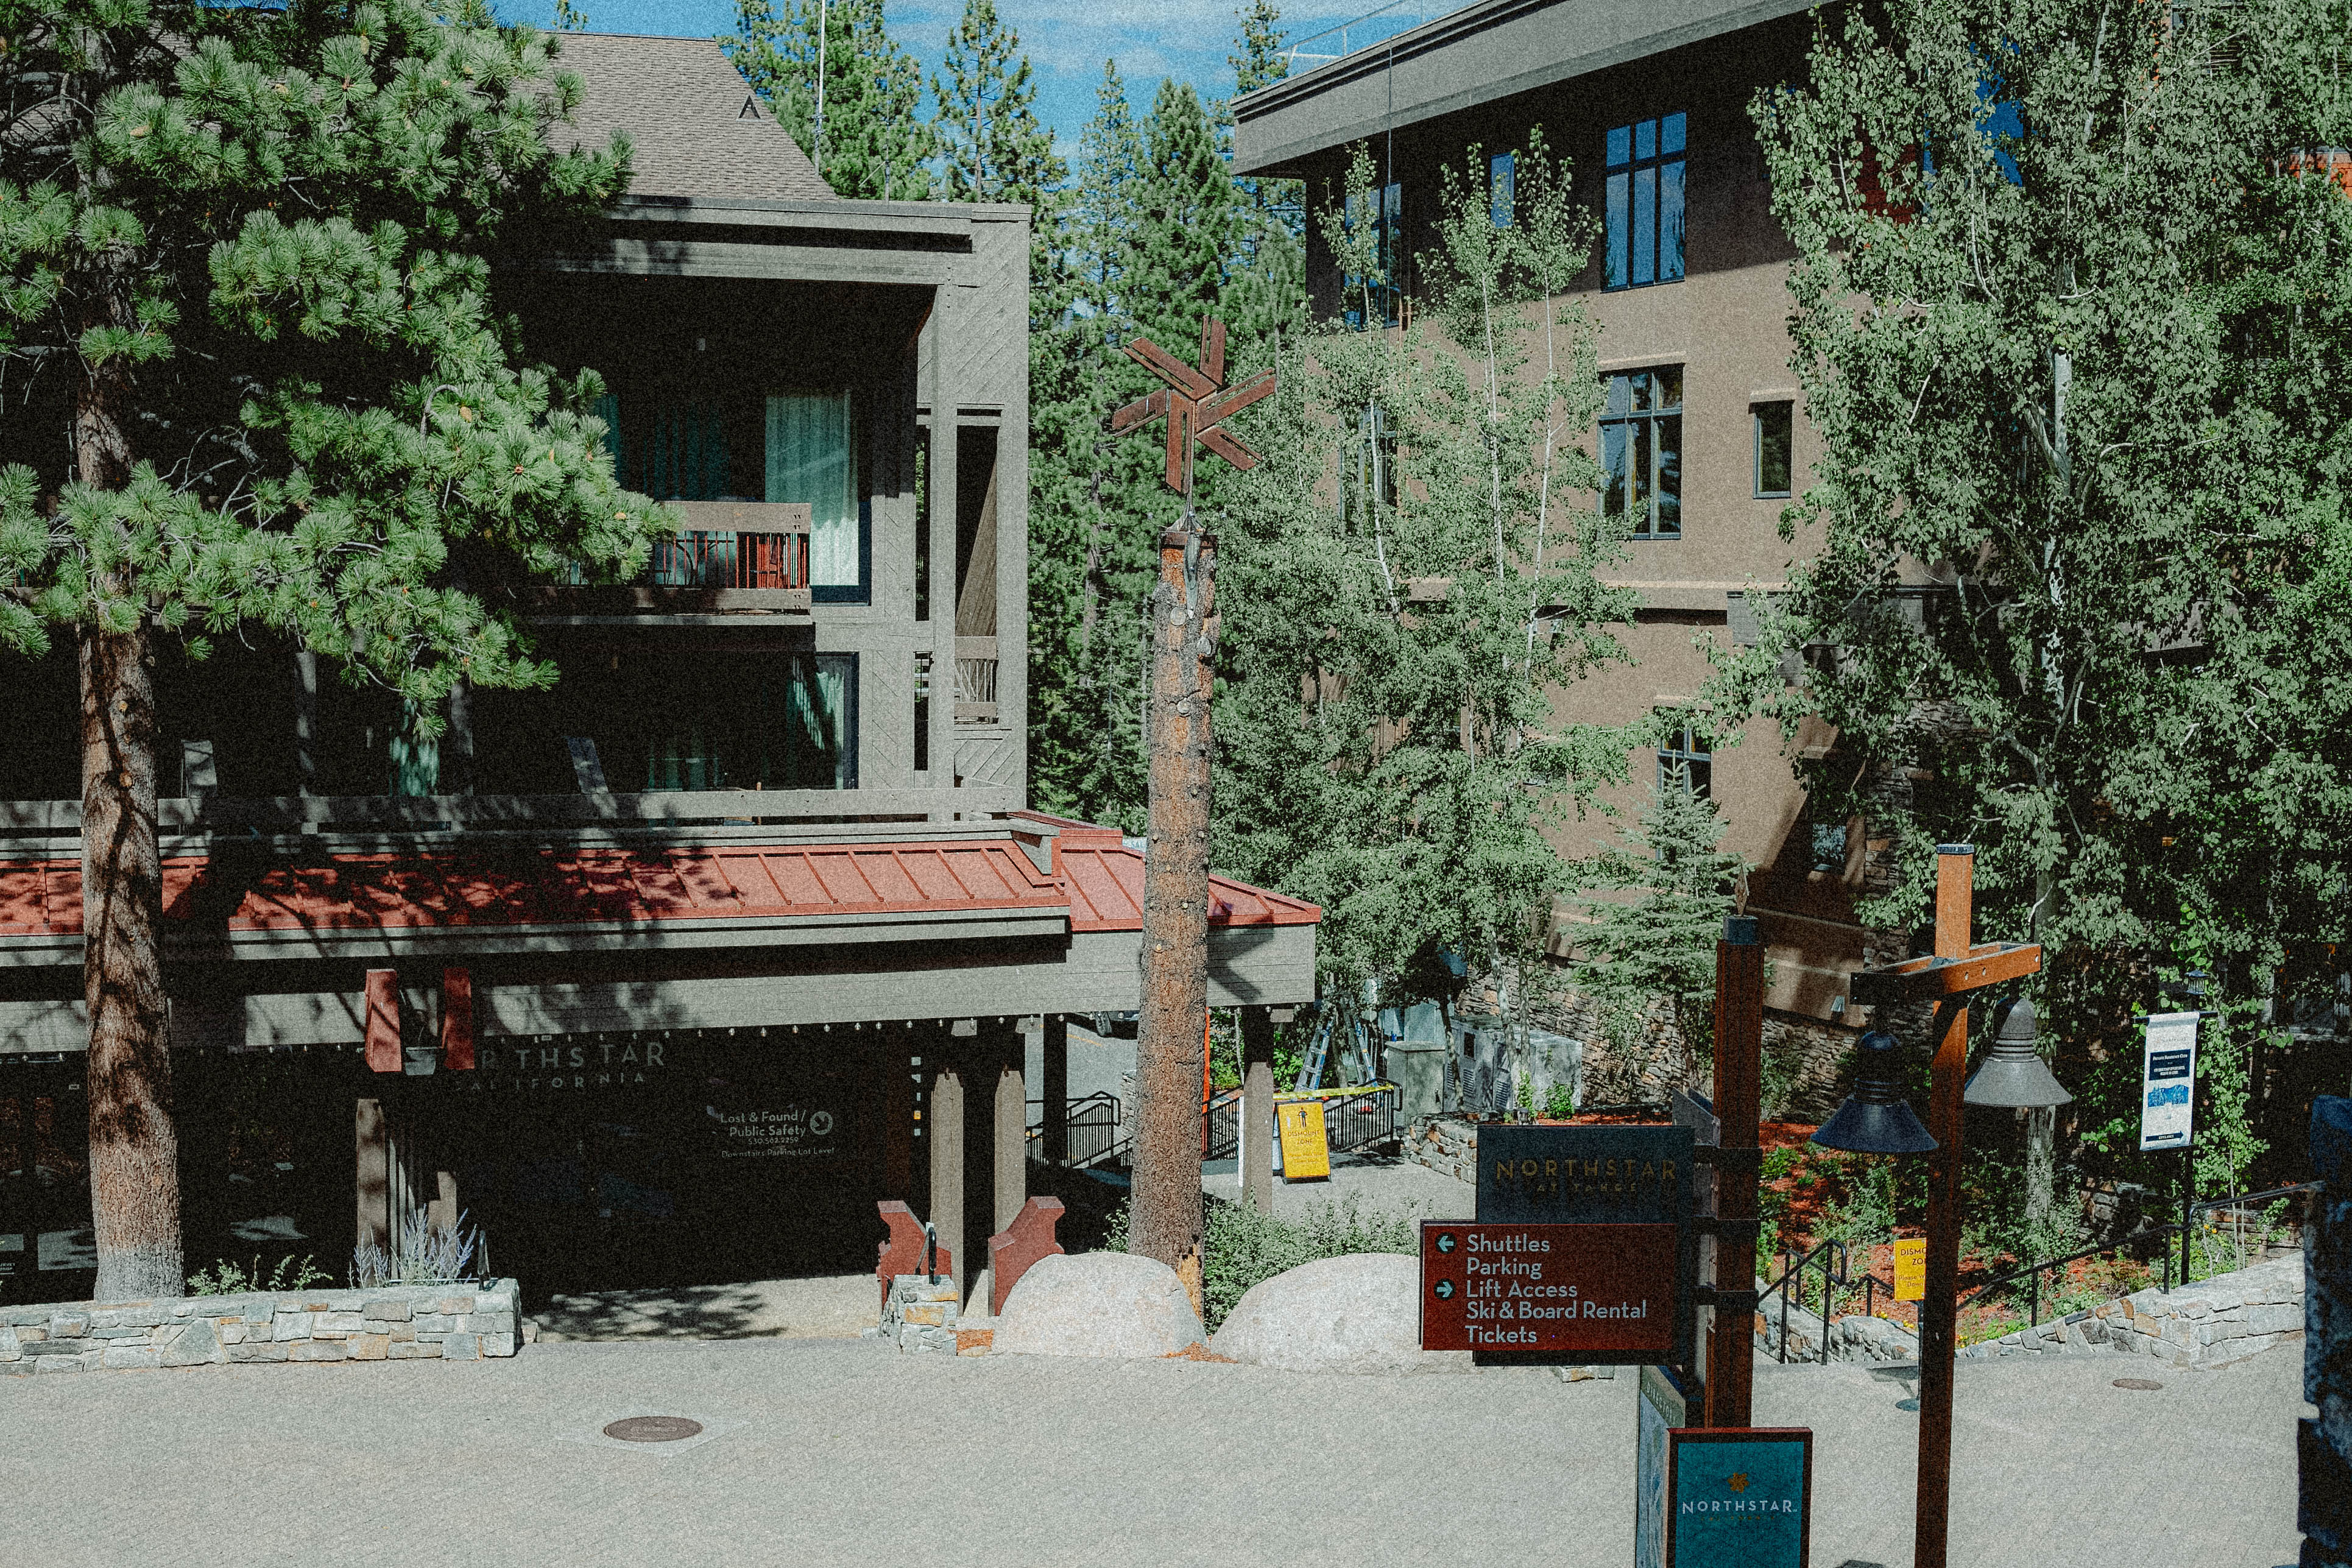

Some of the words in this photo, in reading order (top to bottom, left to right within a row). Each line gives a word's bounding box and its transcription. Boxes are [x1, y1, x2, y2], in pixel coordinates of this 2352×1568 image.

[481, 1041, 665, 1070] RTHSTAR
[721, 1112, 746, 1123] Lost
[749, 1111, 758, 1122] &
[761, 1109, 799, 1122] Found
[800, 1109, 807, 1122] /
[729, 1126, 765, 1137] Public
[768, 1124, 806, 1137] Safety
[721, 1150, 765, 1158] Downstairs
[767, 1148, 796, 1157] Parking
[1496, 1159, 1676, 1181] NORTHSTAR
[1536, 1182, 1558, 1193] AT
[1573, 1182, 1637, 1193] TAHOE
[1466, 1233, 1550, 1252] Shuttles
[1466, 1256, 1542, 1280] Parking
[1466, 1279, 1502, 1298] Lift
[1508, 1280, 1578, 1298] Access
[1466, 1300, 1495, 1319] Ski
[1499, 1302, 1514, 1319] &
[1519, 1300, 1577, 1319] Board
[1583, 1299, 1647, 1319] Rental
[1464, 1324, 1538, 1344] Tickets
[1682, 1500, 1792, 1515] NORTHSTAR
